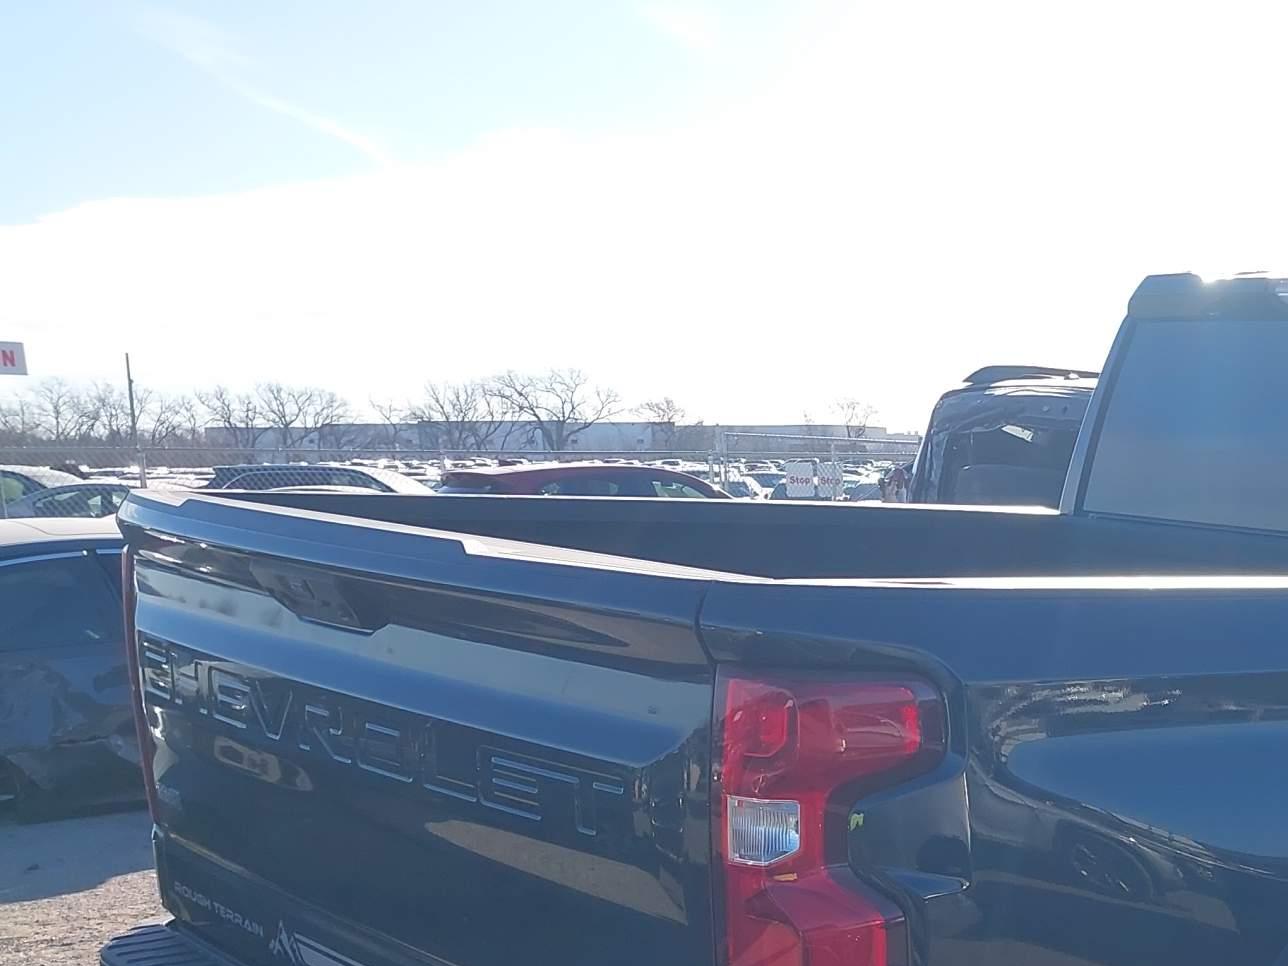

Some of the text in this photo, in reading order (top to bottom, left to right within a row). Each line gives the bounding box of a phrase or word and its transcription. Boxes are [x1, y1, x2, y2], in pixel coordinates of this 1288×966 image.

[789, 475, 811, 486] Stop
[139, 636, 624, 837] CHEVROLET
[173, 880, 264, 937] ROUGH TERRAIN
